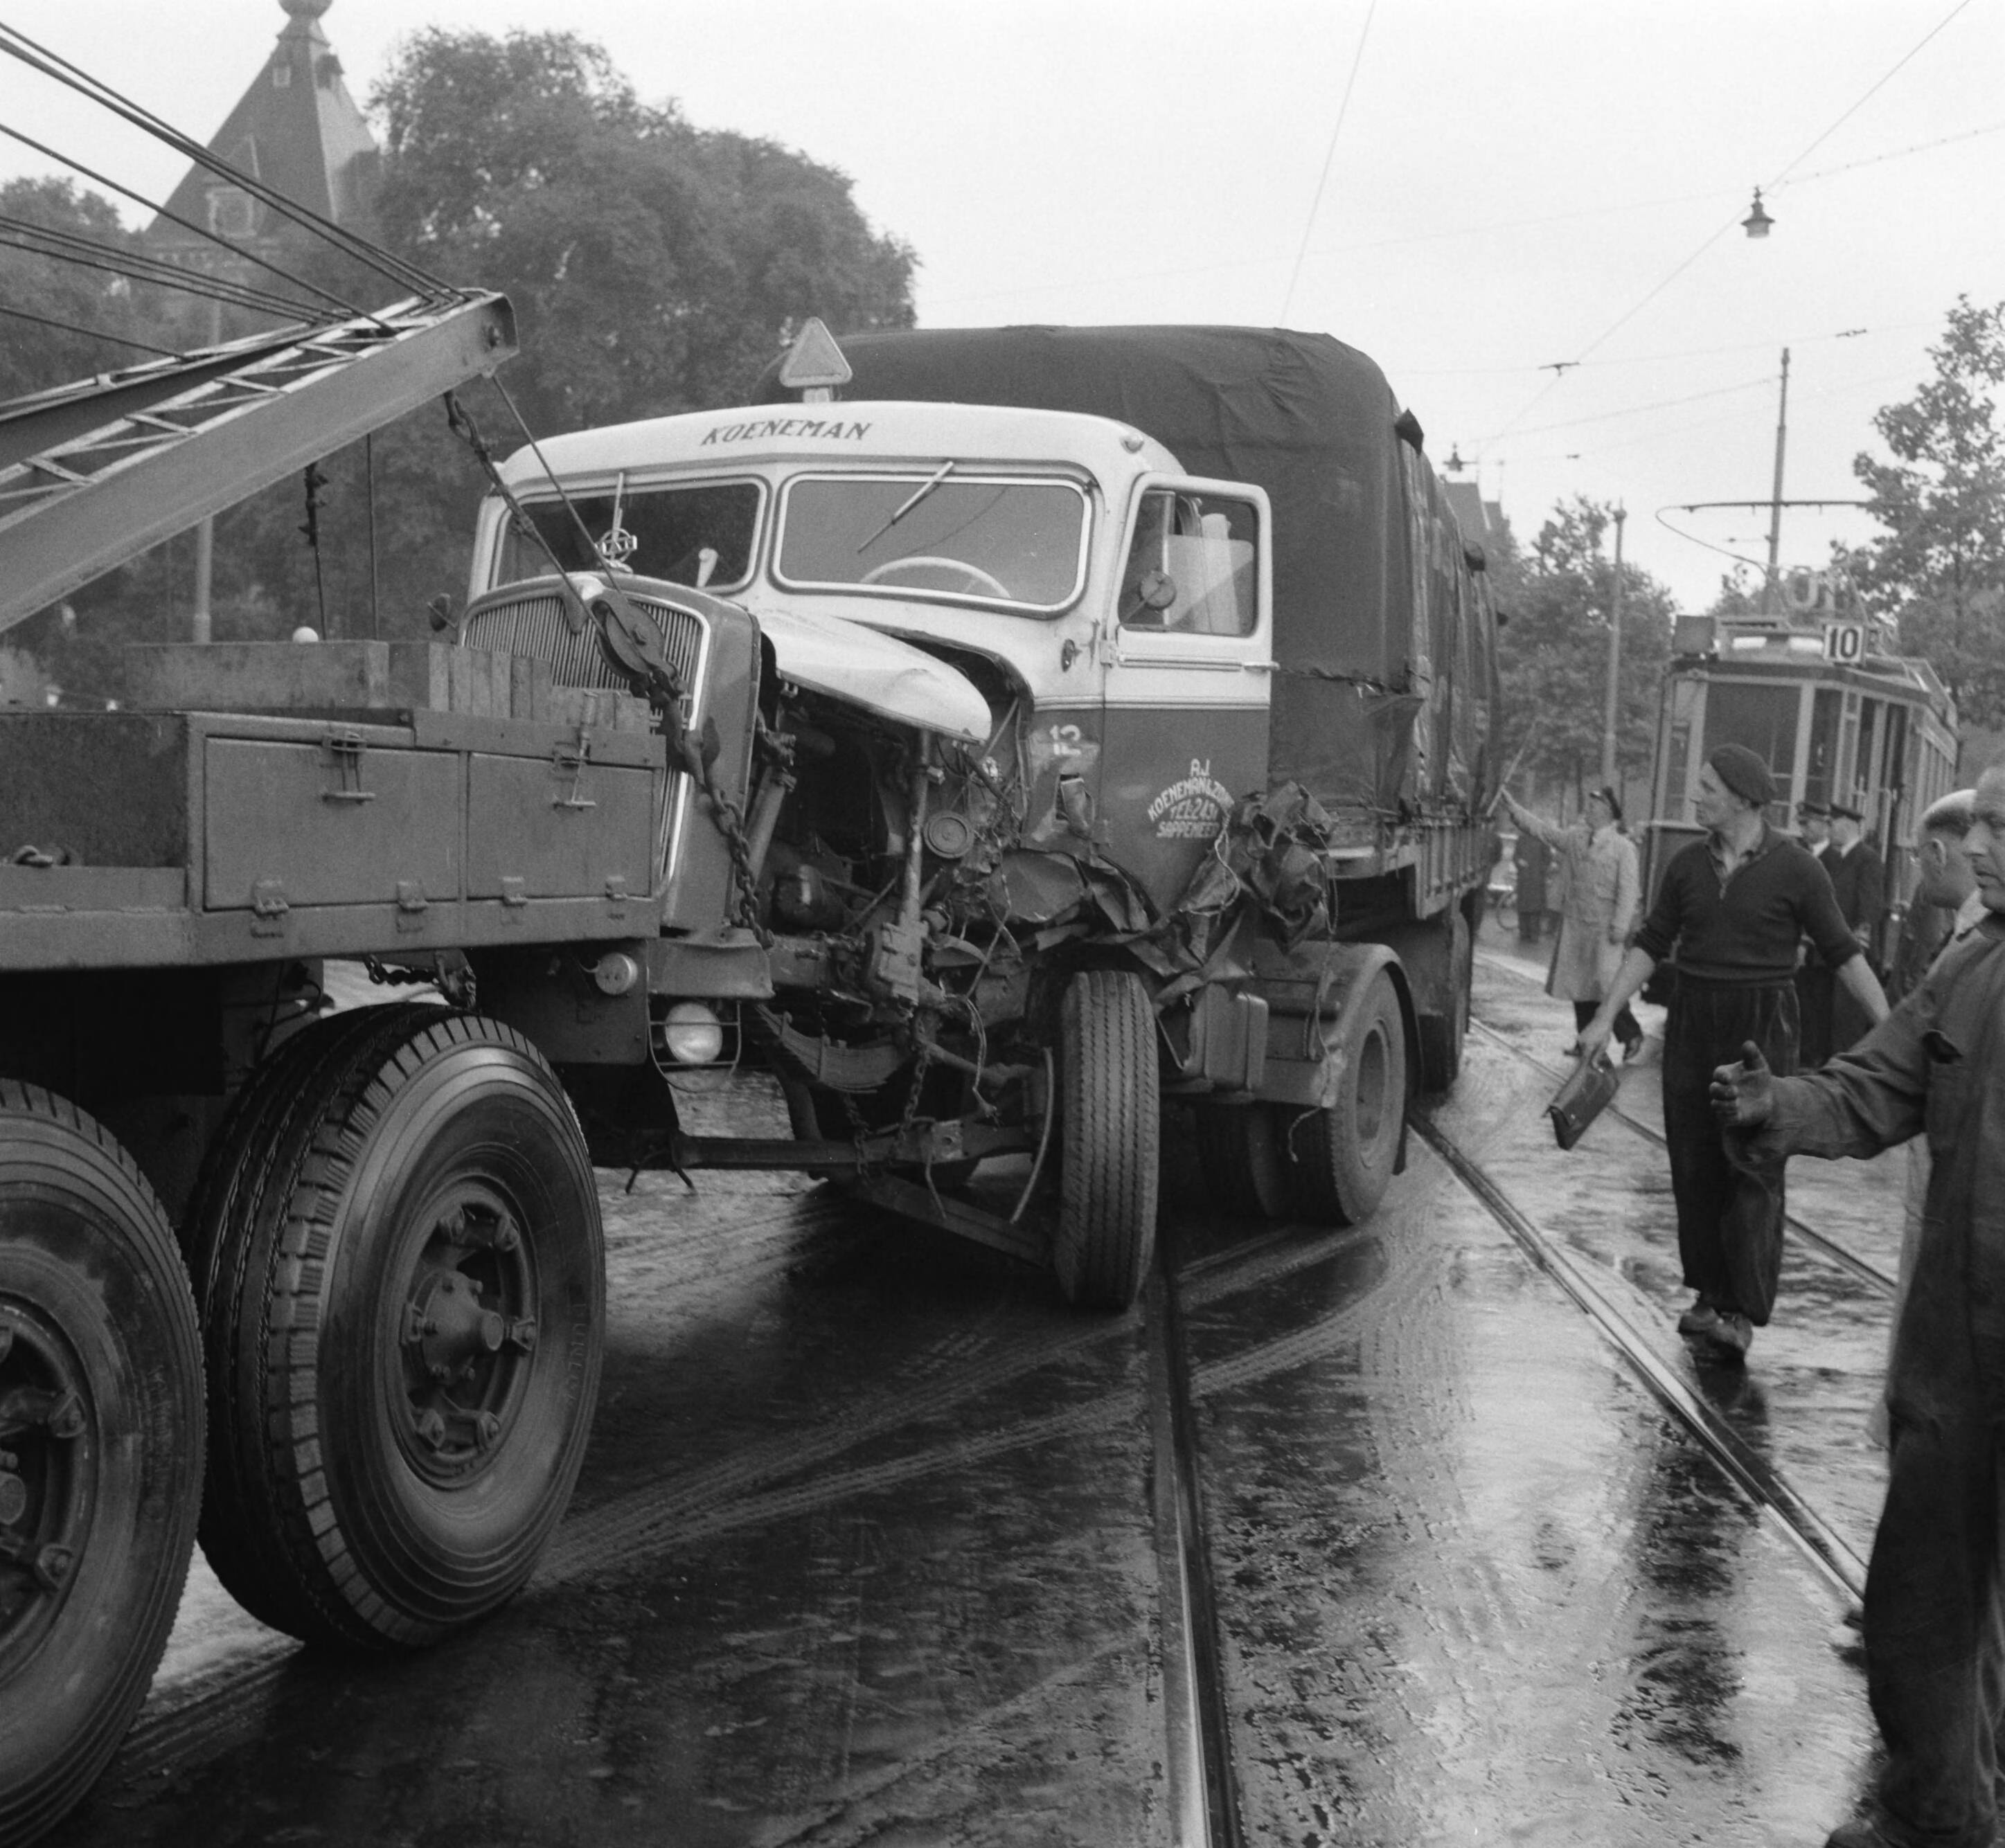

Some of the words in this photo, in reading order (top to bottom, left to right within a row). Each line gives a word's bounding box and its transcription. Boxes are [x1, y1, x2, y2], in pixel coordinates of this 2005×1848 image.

[700, 419, 872, 446] KOENEMAN
[1829, 628, 1859, 658] 10
[1049, 724, 1081, 755] 12
